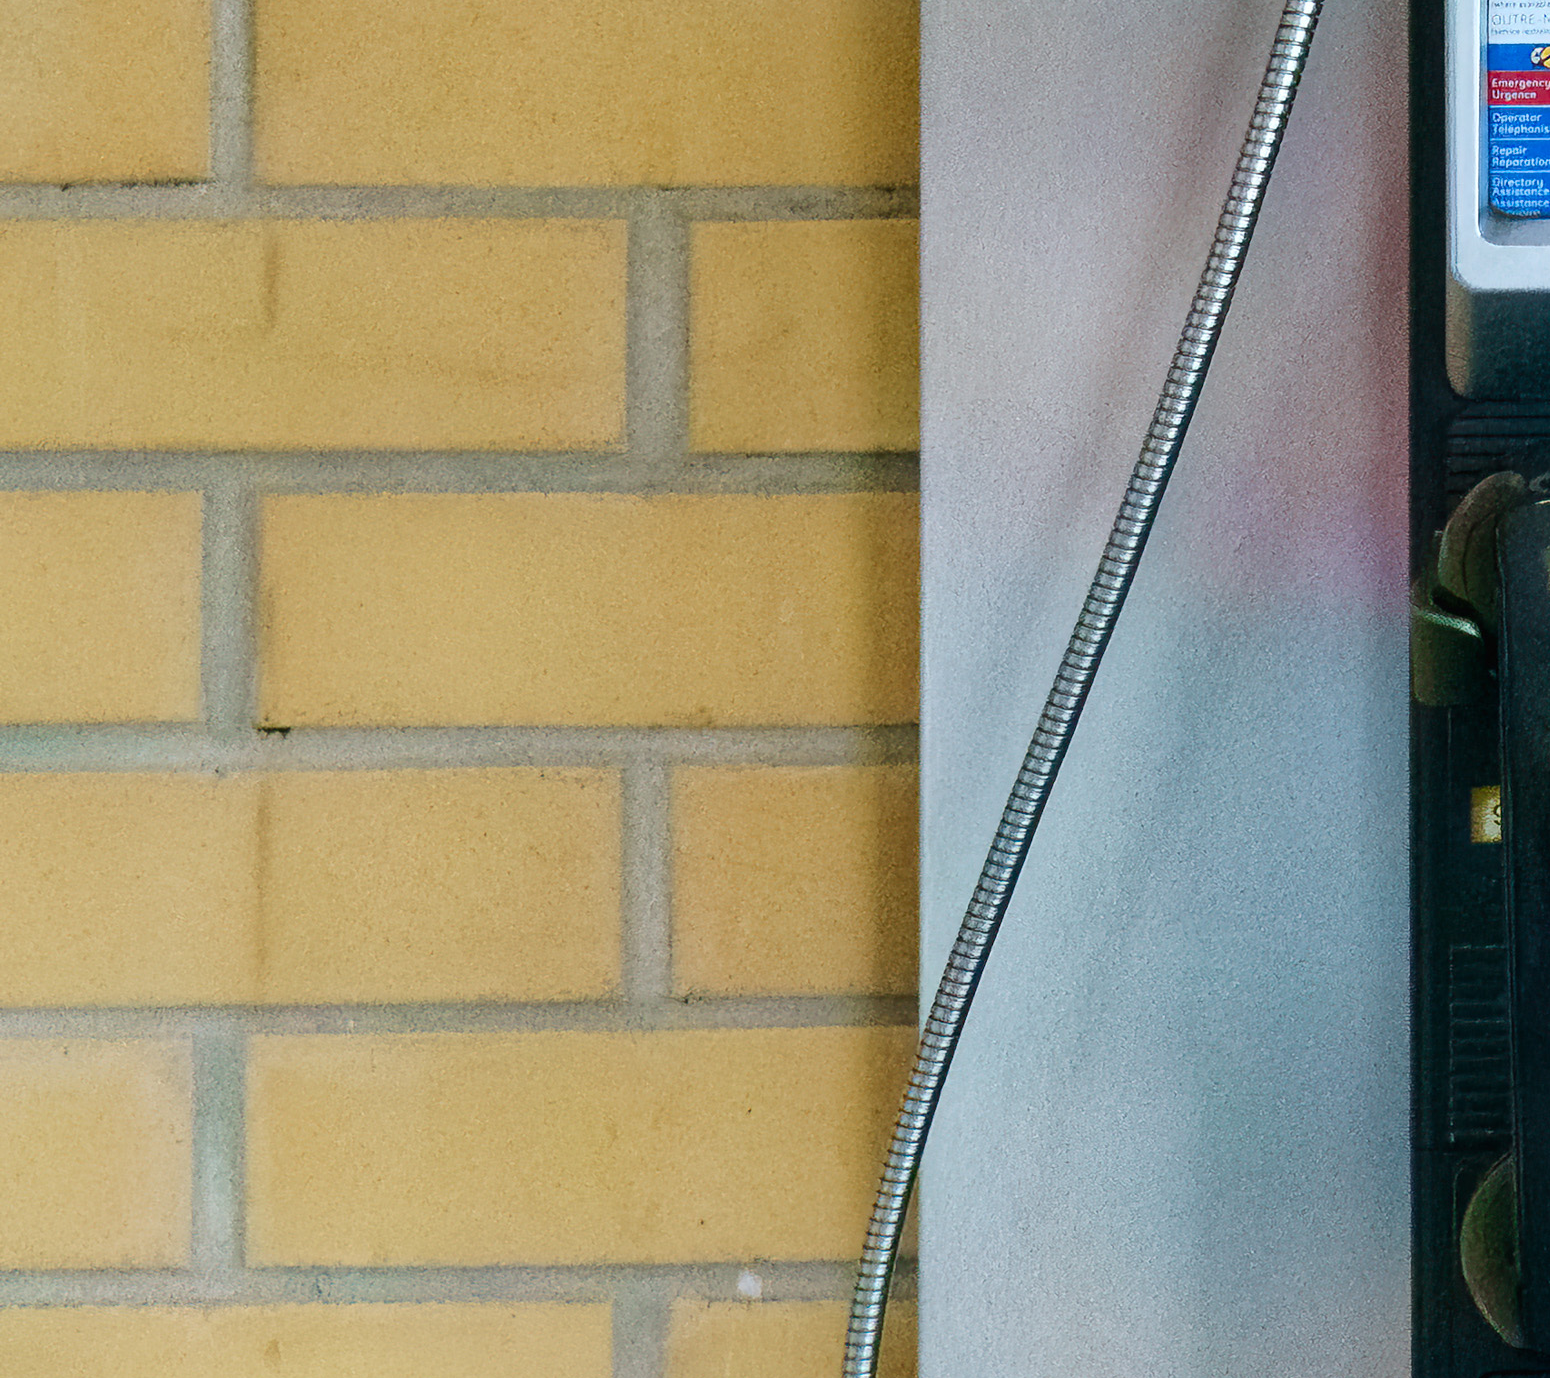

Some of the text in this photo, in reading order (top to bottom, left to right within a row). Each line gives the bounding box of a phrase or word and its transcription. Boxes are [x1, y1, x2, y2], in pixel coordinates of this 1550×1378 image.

[1491, 90, 1537, 100] Urgence
[1492, 113, 1542, 124] Operator
[1492, 146, 1527, 156] Repair
[1492, 177, 1544, 188] Directory
[1492, 187, 1550, 197] Assistance
